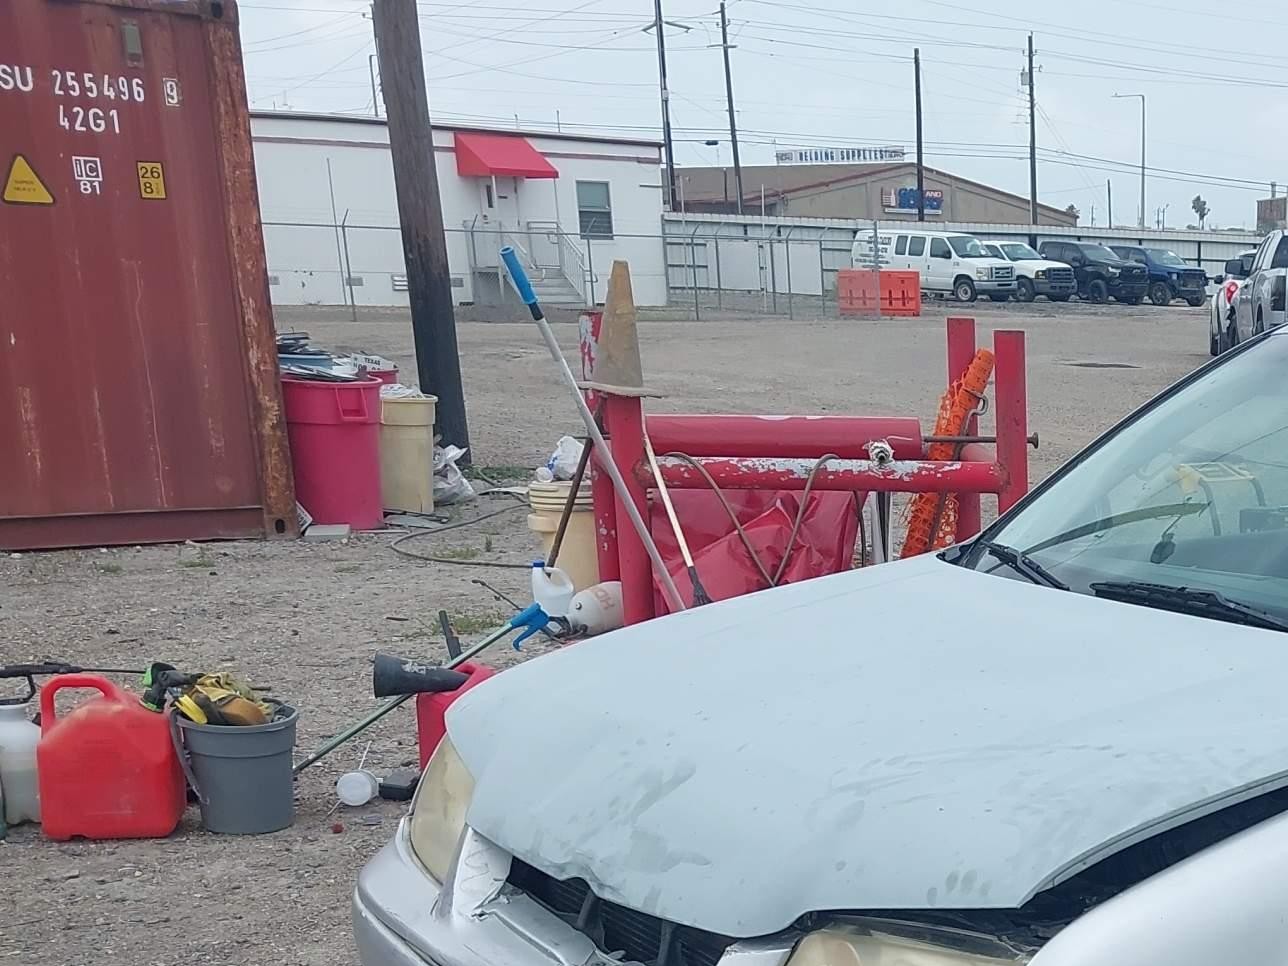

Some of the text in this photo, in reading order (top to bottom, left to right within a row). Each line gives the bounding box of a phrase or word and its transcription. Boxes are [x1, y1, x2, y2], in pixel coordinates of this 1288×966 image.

[0, 64, 179, 104] SU 255496 9
[59, 105, 120, 134] 42G1
